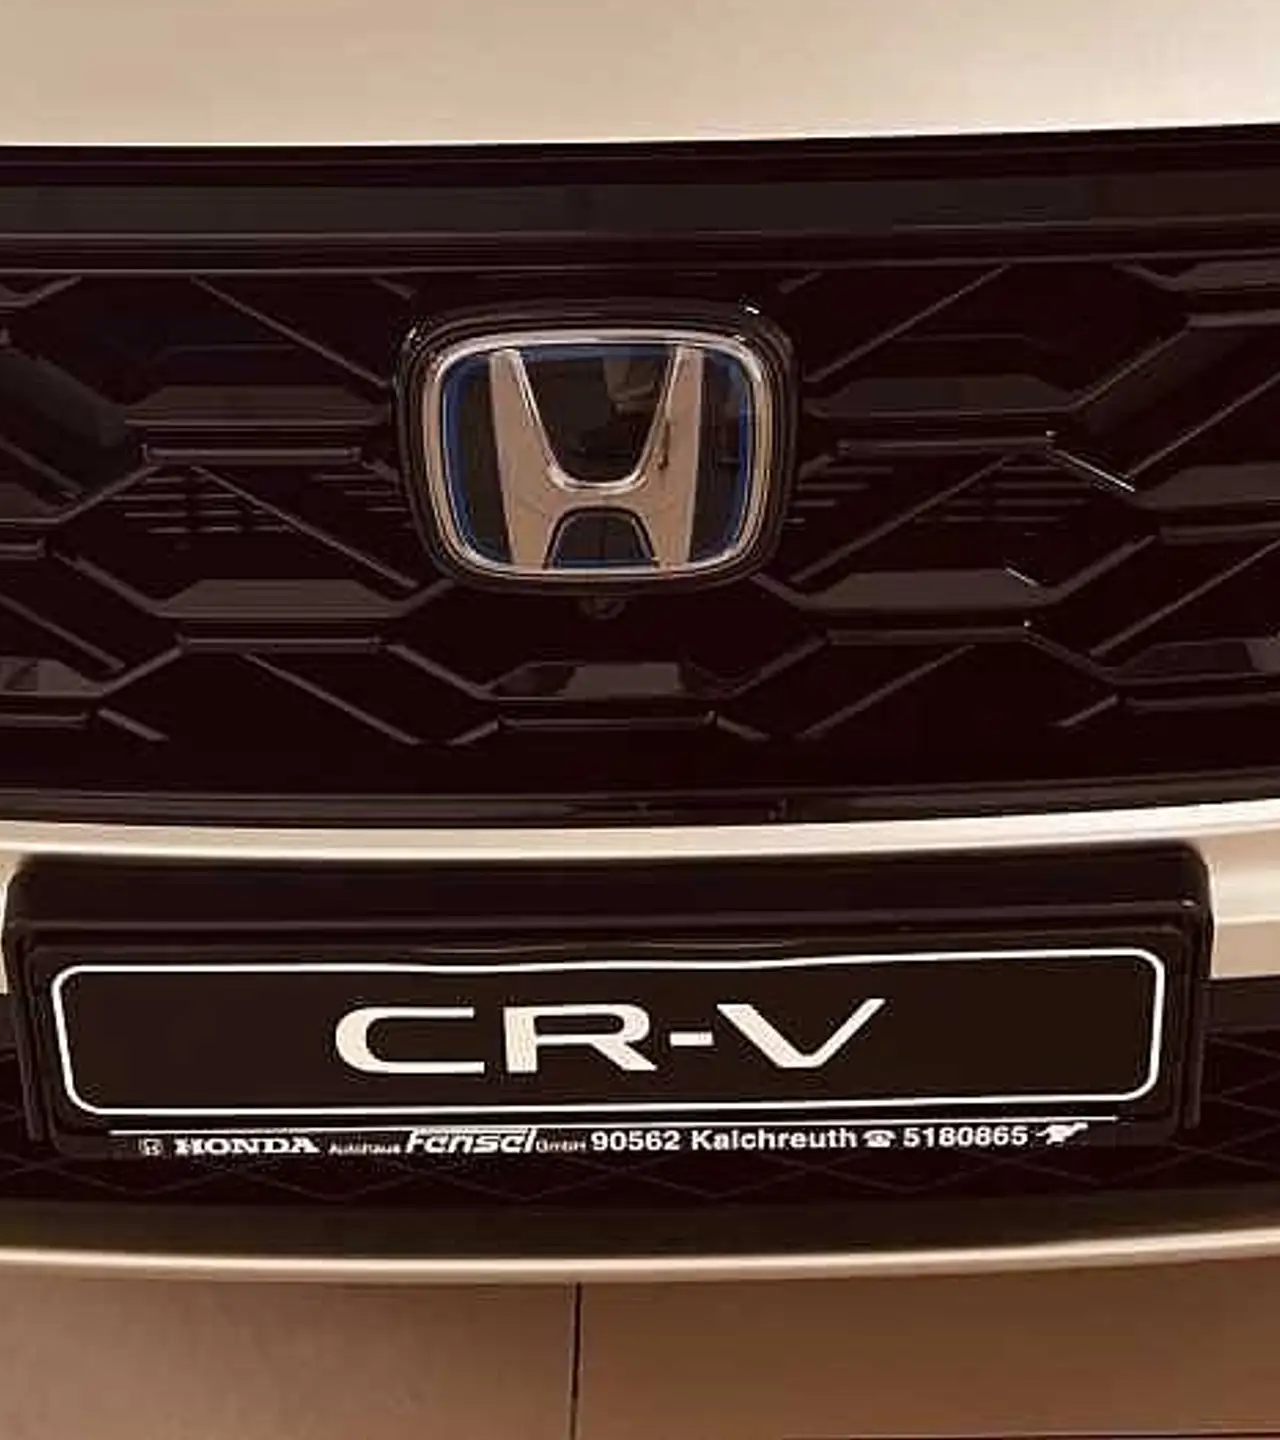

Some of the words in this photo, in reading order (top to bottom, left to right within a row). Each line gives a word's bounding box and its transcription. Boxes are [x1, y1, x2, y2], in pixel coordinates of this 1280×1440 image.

[333, 997, 885, 1074] CR-V
[173, 1136, 320, 1156] HONDA
[327, 1140, 402, 1156] Autohaus
[405, 1127, 538, 1155] Fensel
[590, 1129, 681, 1152] 90562
[691, 1127, 858, 1151] Kalchreuth
[901, 1125, 1029, 1148] 5180865
